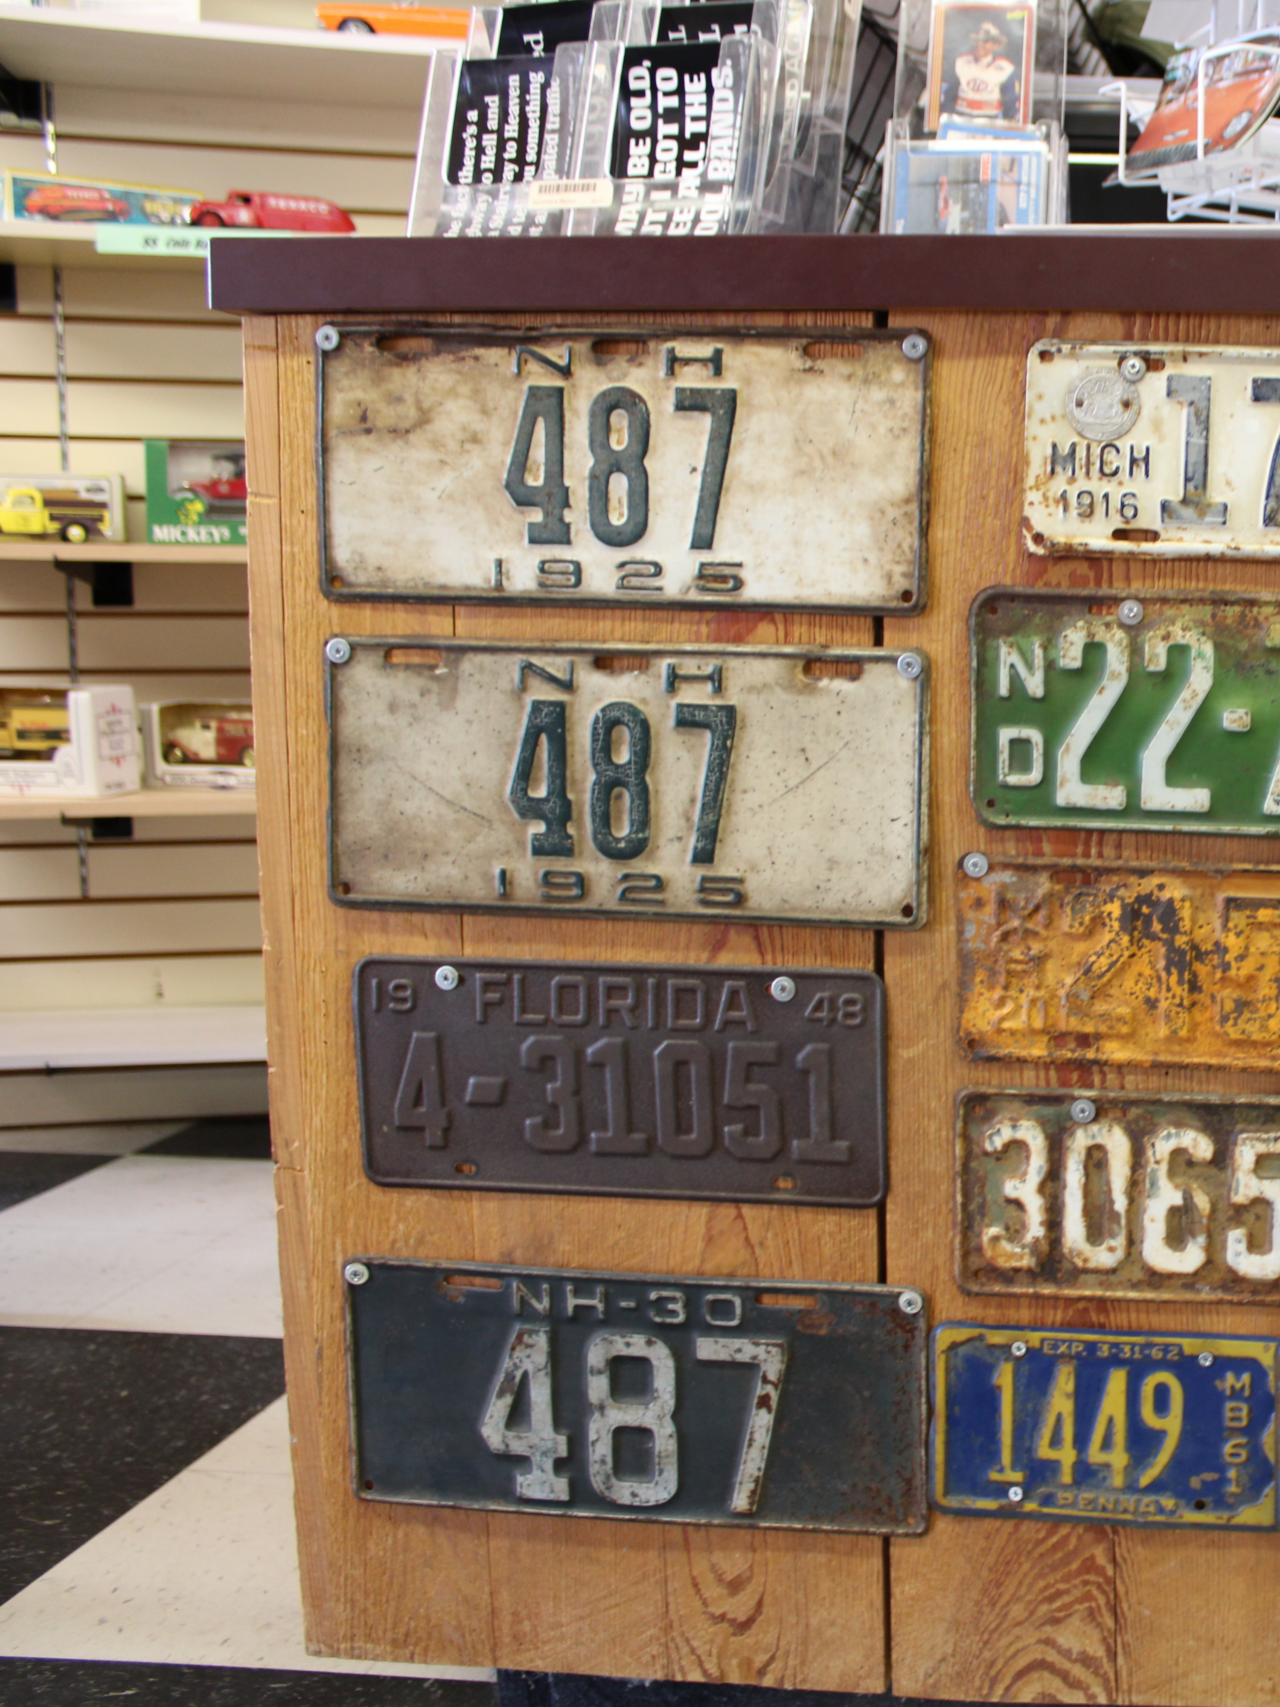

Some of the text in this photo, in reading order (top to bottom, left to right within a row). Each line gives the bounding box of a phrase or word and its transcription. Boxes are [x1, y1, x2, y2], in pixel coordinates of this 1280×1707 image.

[466, 109, 478, 123] a
[484, 95, 500, 131] and
[504, 74, 521, 139] Heaven
[524, 71, 545, 163] something
[628, 59, 652, 131] OLD,
[654, 67, 679, 114] TO
[683, 72, 707, 139] THE
[707, 58, 736, 181] BANDS.
[457, 126, 479, 184] there's
[480, 133, 498, 170] Hell
[503, 142, 518, 160] to
[627, 137, 651, 177] BE
[653, 118, 679, 179] GOT
[678, 141, 706, 199] ALL
[268, 196, 330, 215] TEXACO
[489, 161, 519, 229] Stairway
[503, 384, 738, 551] 487
[1047, 440, 1152, 481] MICH
[1057, 488, 1140, 522] 1916
[493, 556, 744, 594] 1925
[508, 699, 737, 866] 487
[497, 866, 745, 907] 1925
[371, 971, 867, 1034] 19 FLORIDA 48
[392, 1030, 853, 1164] 4-31051
[511, 1281, 743, 1328] NH-30
[480, 1325, 787, 1515] 487
[988, 1357, 1185, 1490] 1449
